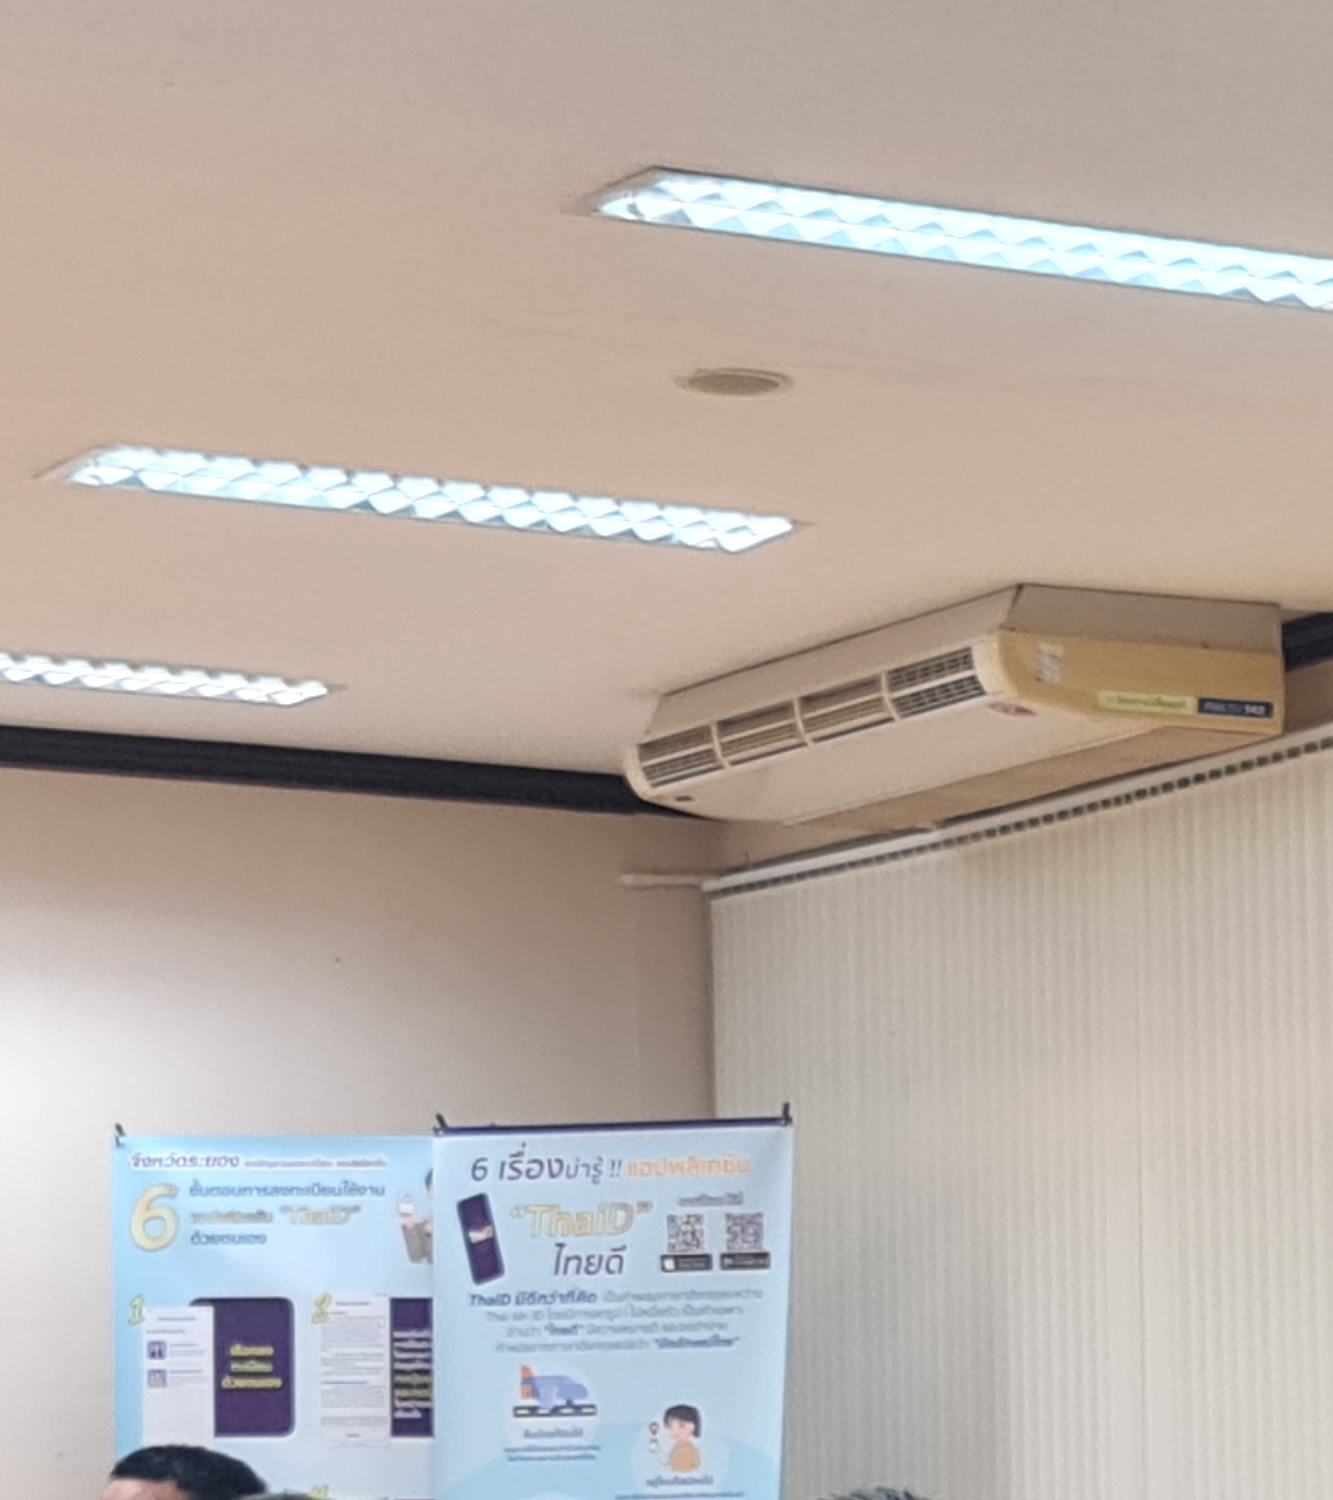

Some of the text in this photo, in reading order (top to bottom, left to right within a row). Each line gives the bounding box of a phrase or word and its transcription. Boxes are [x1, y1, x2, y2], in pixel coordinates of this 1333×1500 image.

[470, 1156, 489, 1182] 6
[129, 1182, 180, 1252] 6
[553, 1242, 627, 1277] ไทยดี
